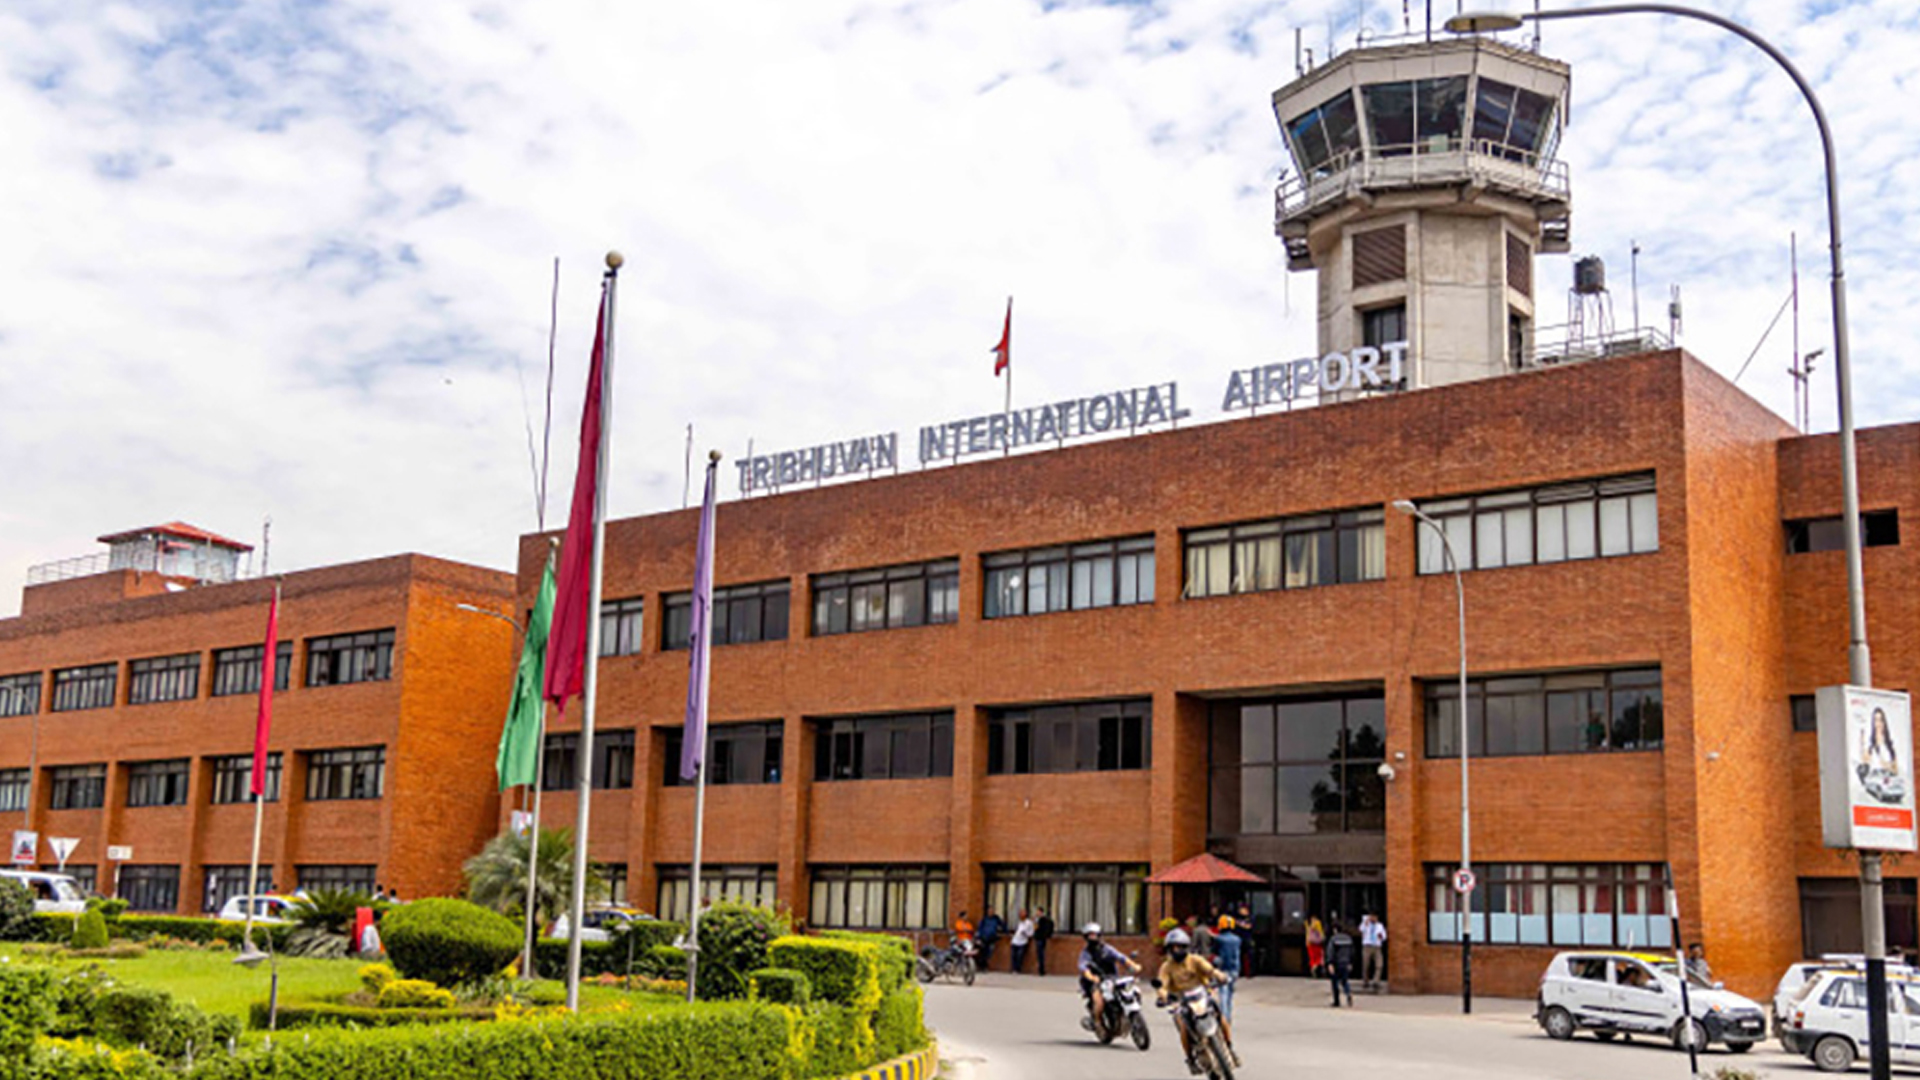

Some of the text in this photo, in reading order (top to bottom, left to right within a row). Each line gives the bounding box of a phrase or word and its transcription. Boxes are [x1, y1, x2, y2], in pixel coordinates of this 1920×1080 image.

[735, 341, 1409, 492] TRIBHUVAN INTERNATIONAL AIRPORT
